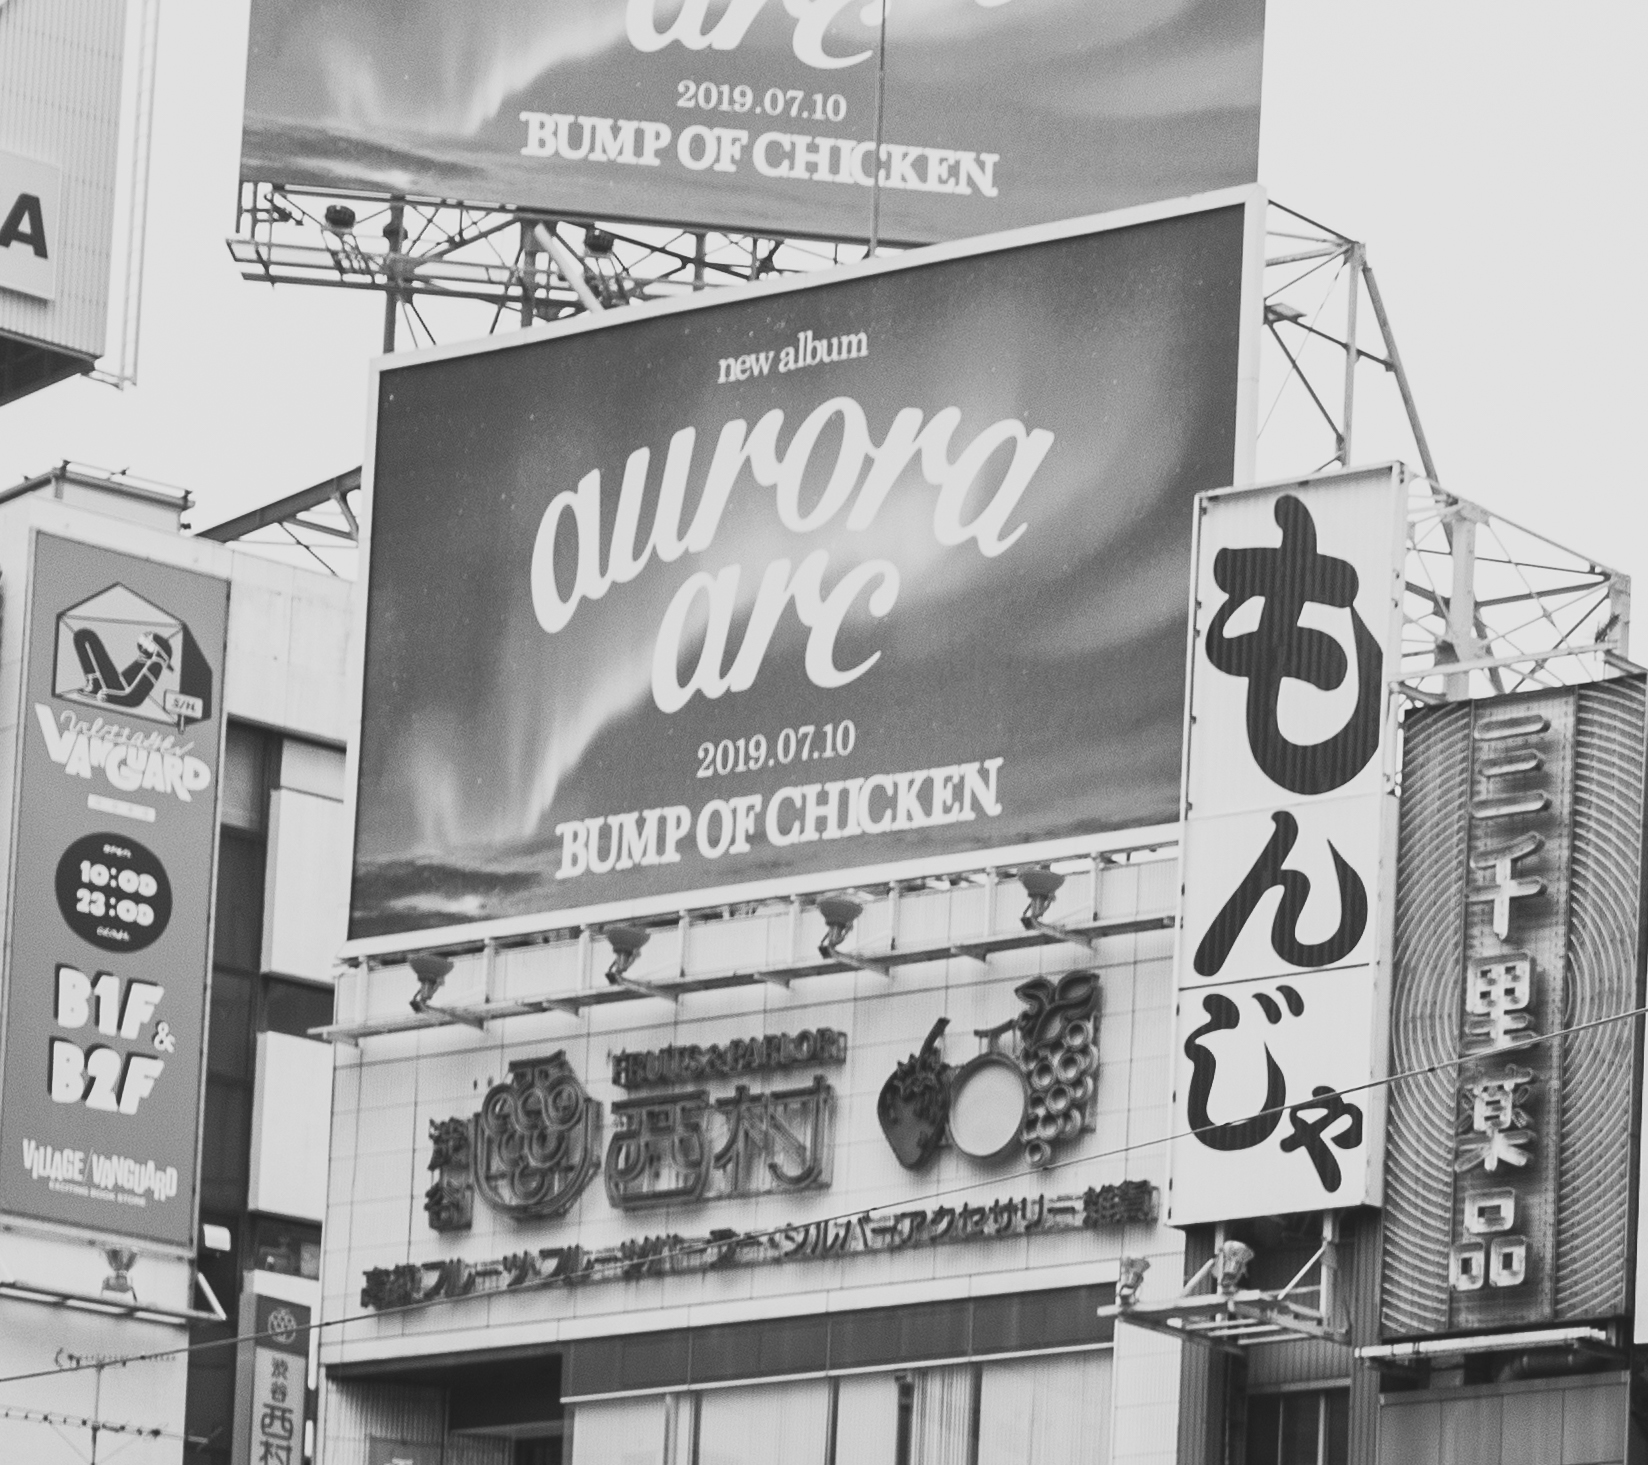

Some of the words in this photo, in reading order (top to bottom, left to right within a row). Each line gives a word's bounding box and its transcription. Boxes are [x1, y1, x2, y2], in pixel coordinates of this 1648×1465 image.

[676, 80, 847, 122] 2019.07.10
[521, 112, 671, 166] BUMP
[676, 124, 745, 172] OF
[751, 133, 1001, 197] CHICKEN
[717, 348, 772, 384] new
[778, 329, 869, 372] album
[529, 394, 1055, 633] aurora
[651, 556, 902, 712] arc
[696, 718, 857, 781] 2019.07.10
[554, 792, 689, 881] BUMP
[689, 787, 758, 860] OF
[761, 757, 1004, 852] CHICKEN
[1186, 494, 1384, 1194] もんじゃ
[57, 966, 165, 1040] B1F
[1449, 712, 1552, 1291] 三千里薬品
[50, 1040, 165, 1116] B2F
